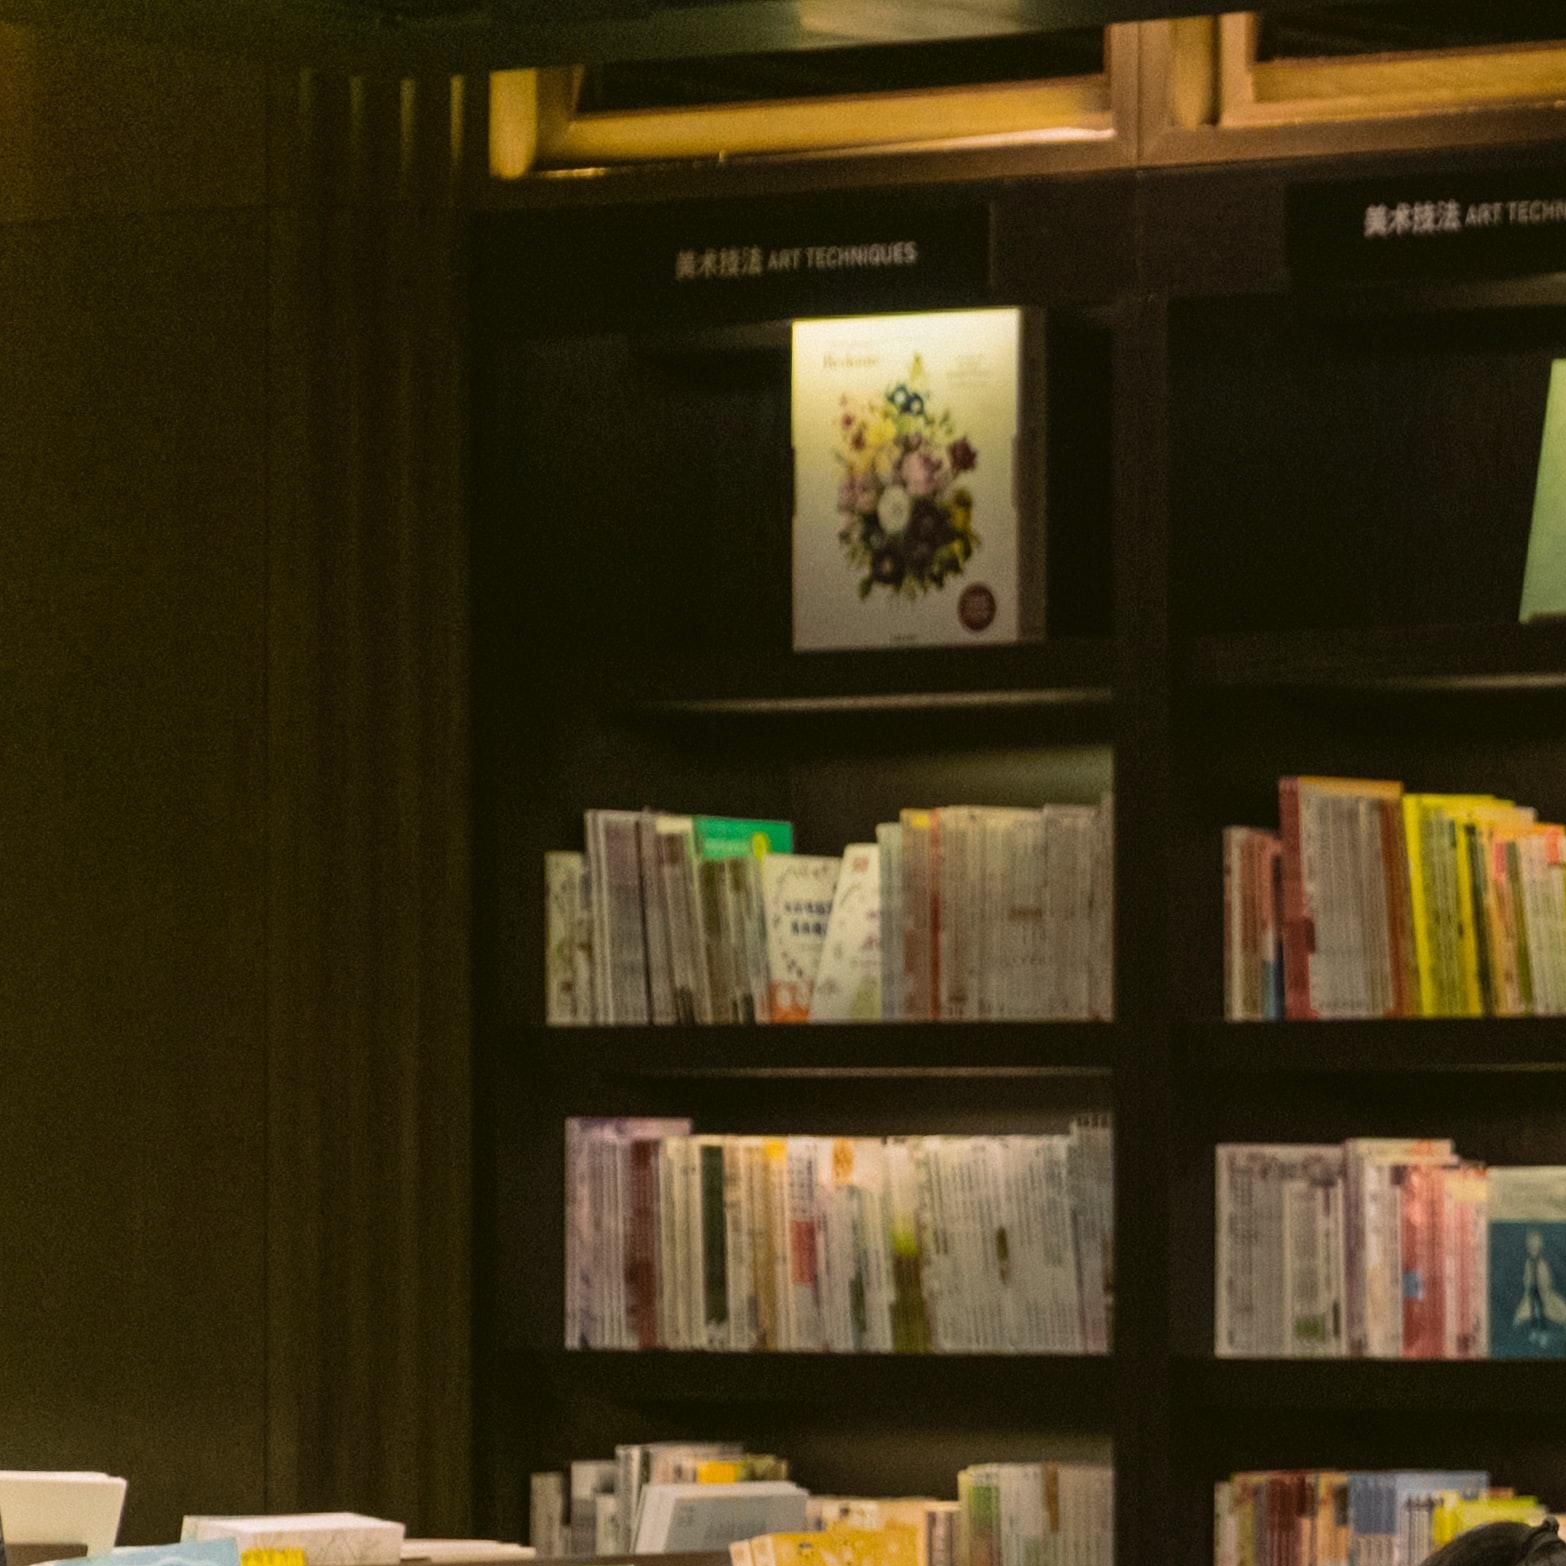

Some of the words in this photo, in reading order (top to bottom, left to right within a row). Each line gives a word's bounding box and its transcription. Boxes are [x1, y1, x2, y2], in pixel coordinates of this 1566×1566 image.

[1465, 202, 1503, 227] ART
[767, 248, 801, 272] ART
[804, 241, 919, 271] TECHNIQUES
